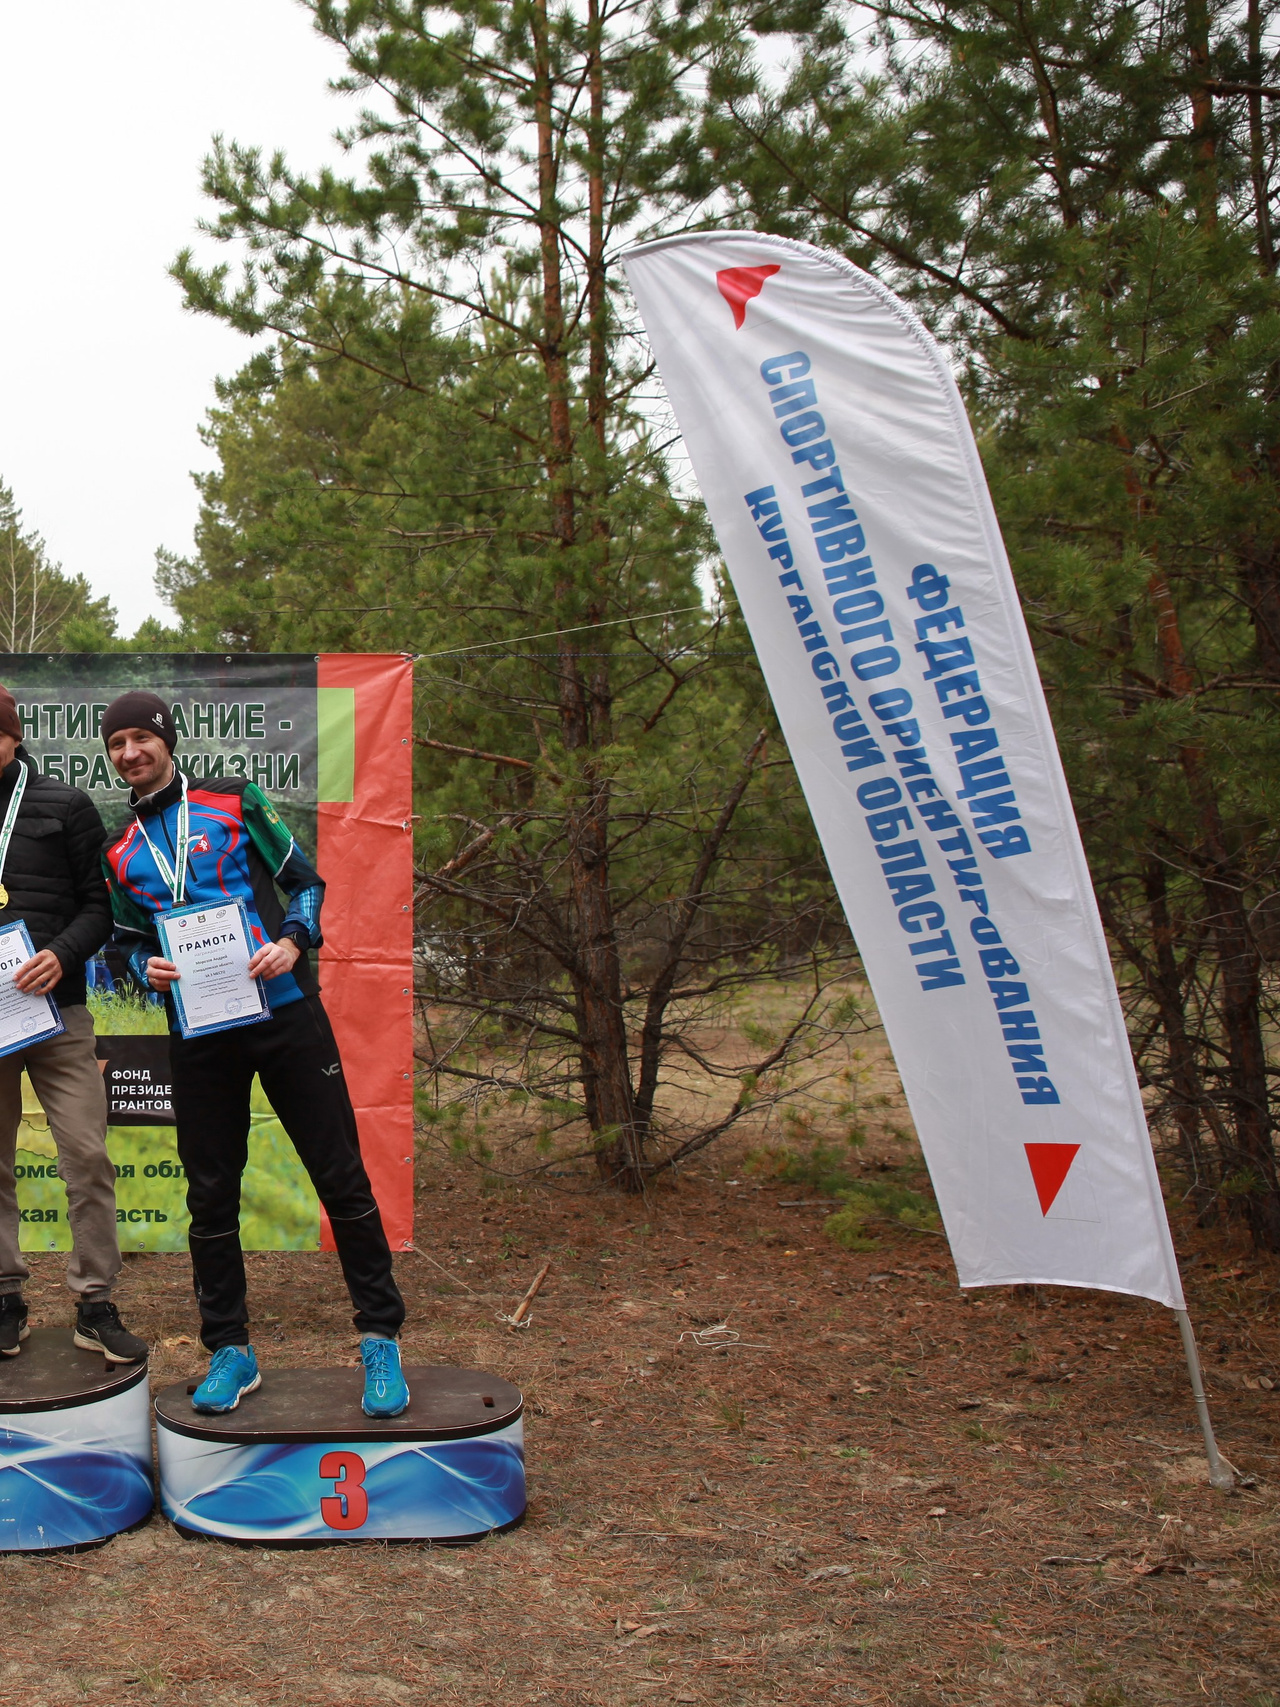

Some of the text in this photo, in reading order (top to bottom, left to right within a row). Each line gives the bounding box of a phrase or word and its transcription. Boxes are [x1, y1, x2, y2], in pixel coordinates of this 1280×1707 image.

[760, 351, 1061, 1105] СПОРТИВНОГО ОРИЕНТИРОВАНИЯ
[906, 563, 1032, 859] ФЕДЕРАЦИЯ
[856, 776, 966, 991] ОБЛАСТИ
[178, 932, 237, 953] ГРАМОТА
[111, 1069, 151, 1081] ФОНД
[111, 1084, 172, 1097] ПРЕЗИДЕ
[111, 1100, 172, 1111] ГРАНТОВ
[319, 1450, 368, 1530] 3
